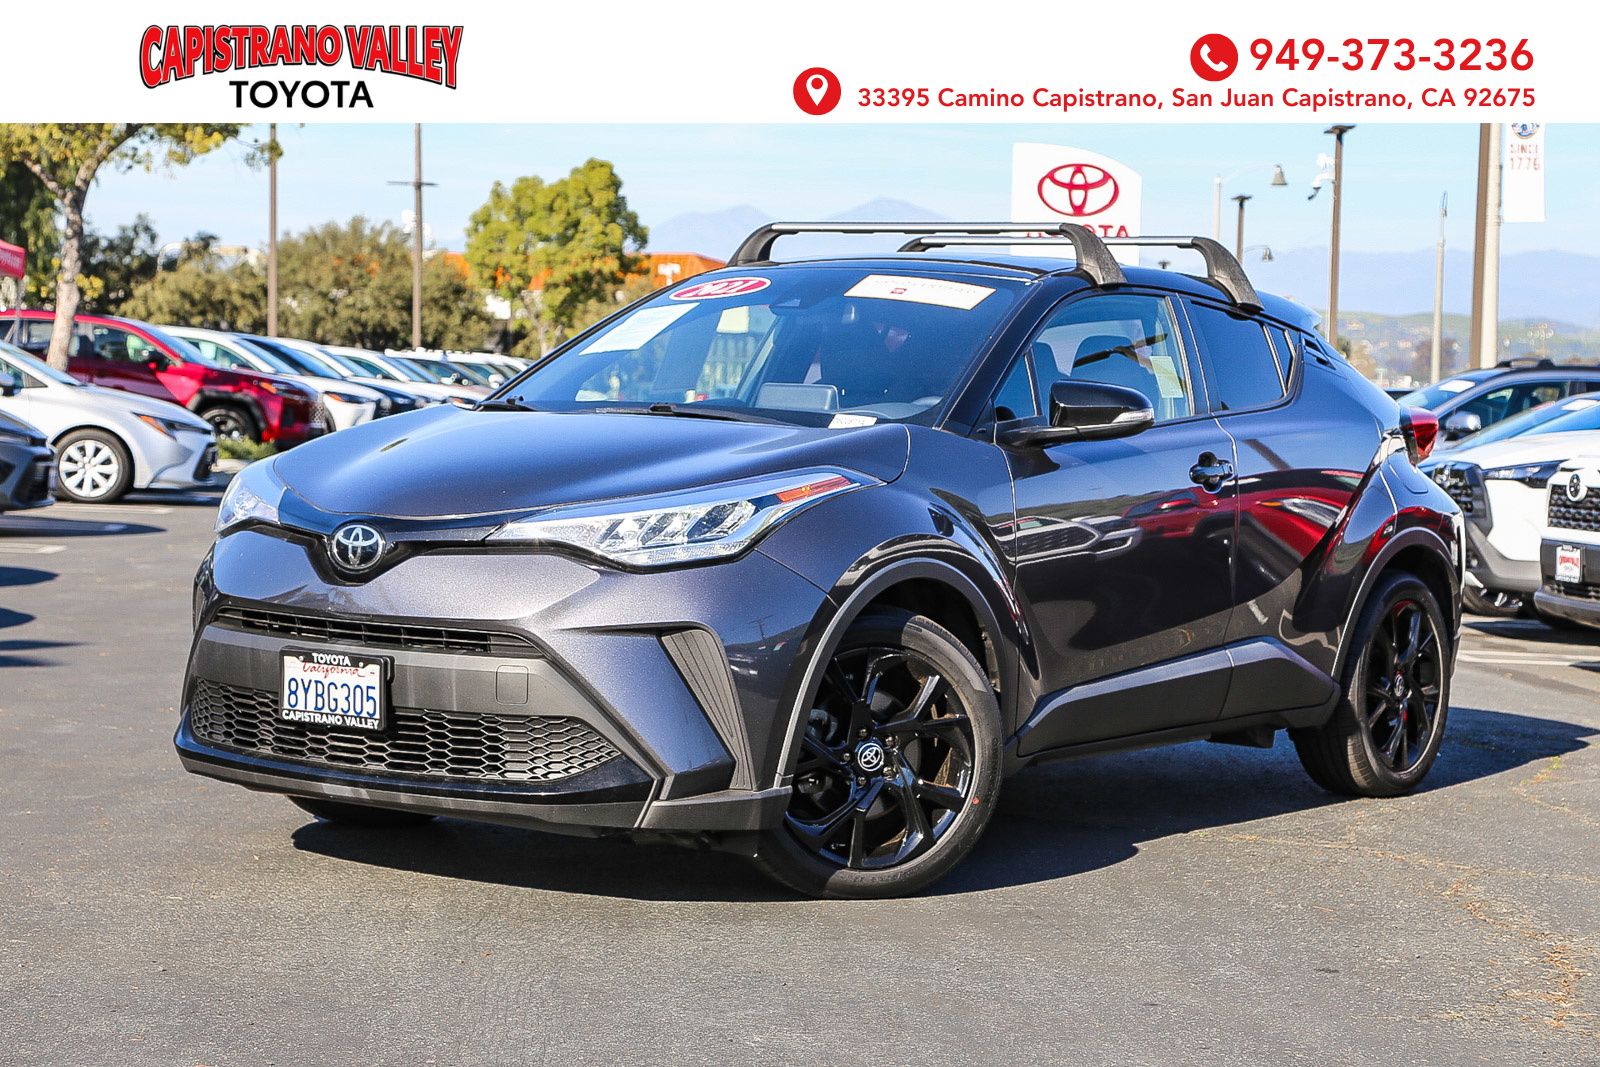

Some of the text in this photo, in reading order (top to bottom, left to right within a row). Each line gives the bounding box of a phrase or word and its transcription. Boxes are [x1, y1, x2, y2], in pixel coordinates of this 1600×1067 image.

[1510, 156, 1541, 171] 1776
[312, 652, 351, 667] TOYOTA
[287, 677, 377, 718] 8YBG305
[281, 709, 379, 730] CAPISTRANO VALLEY
